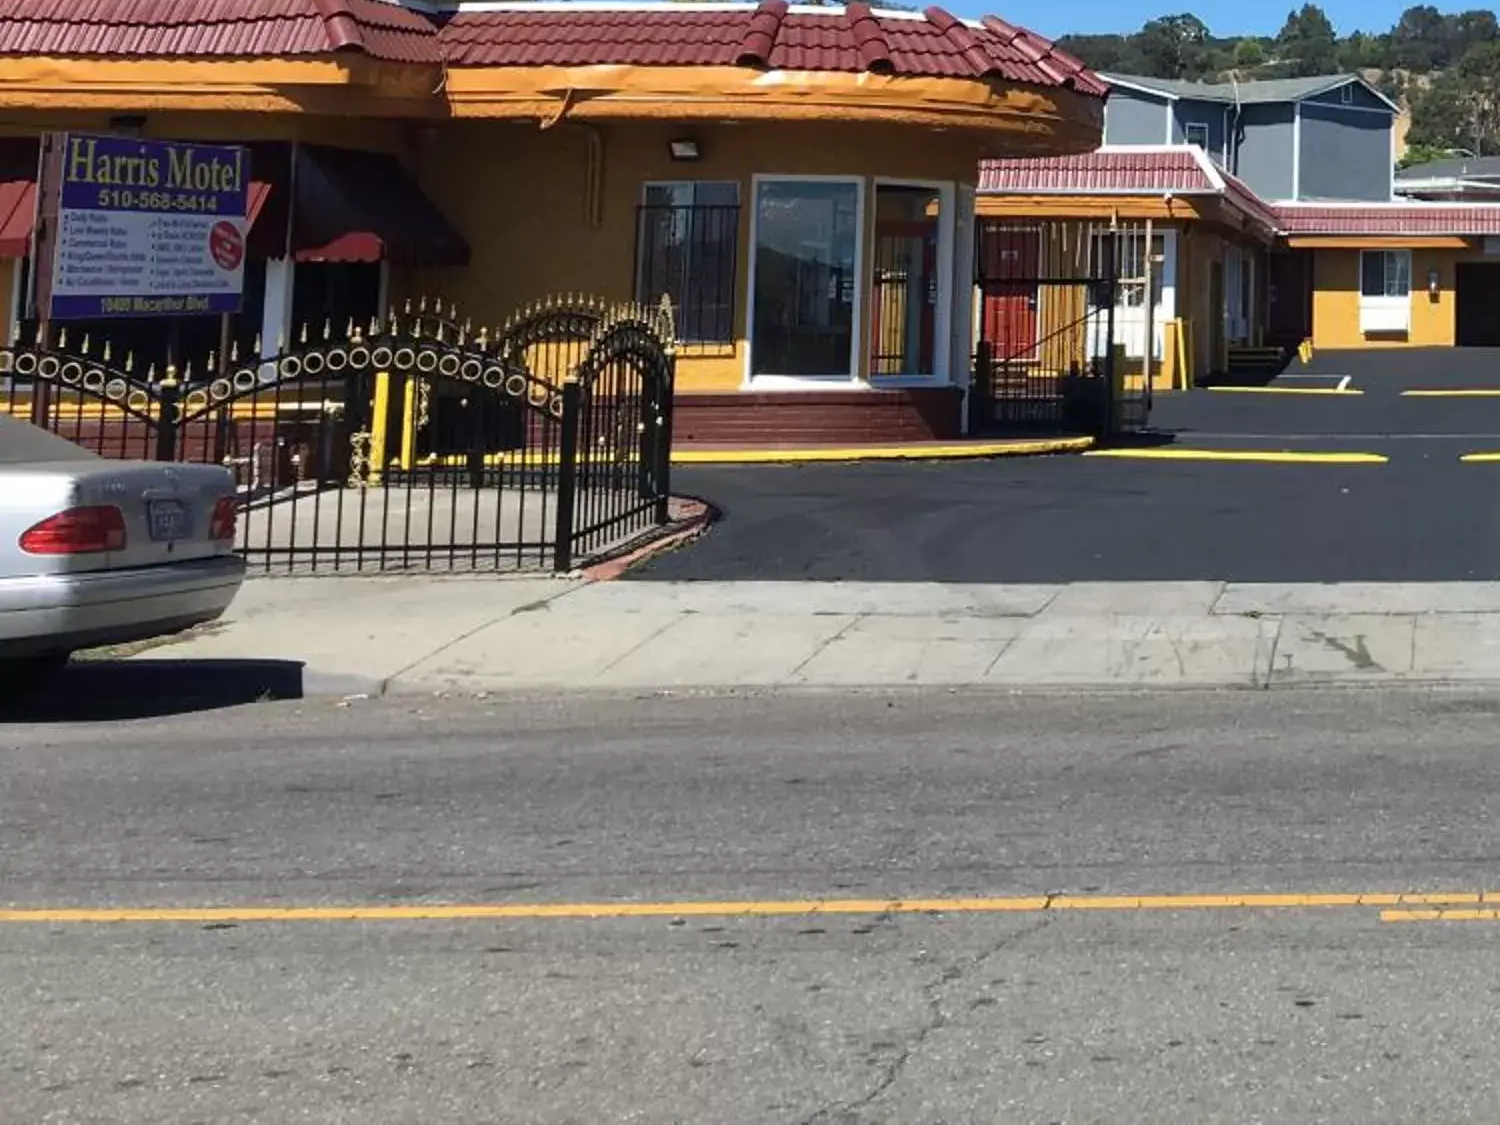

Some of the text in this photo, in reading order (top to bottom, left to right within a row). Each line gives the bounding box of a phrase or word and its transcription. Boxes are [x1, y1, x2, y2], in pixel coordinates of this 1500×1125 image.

[66, 137, 242, 192] Harris Motel
[98, 189, 217, 211] 510-568-5414
